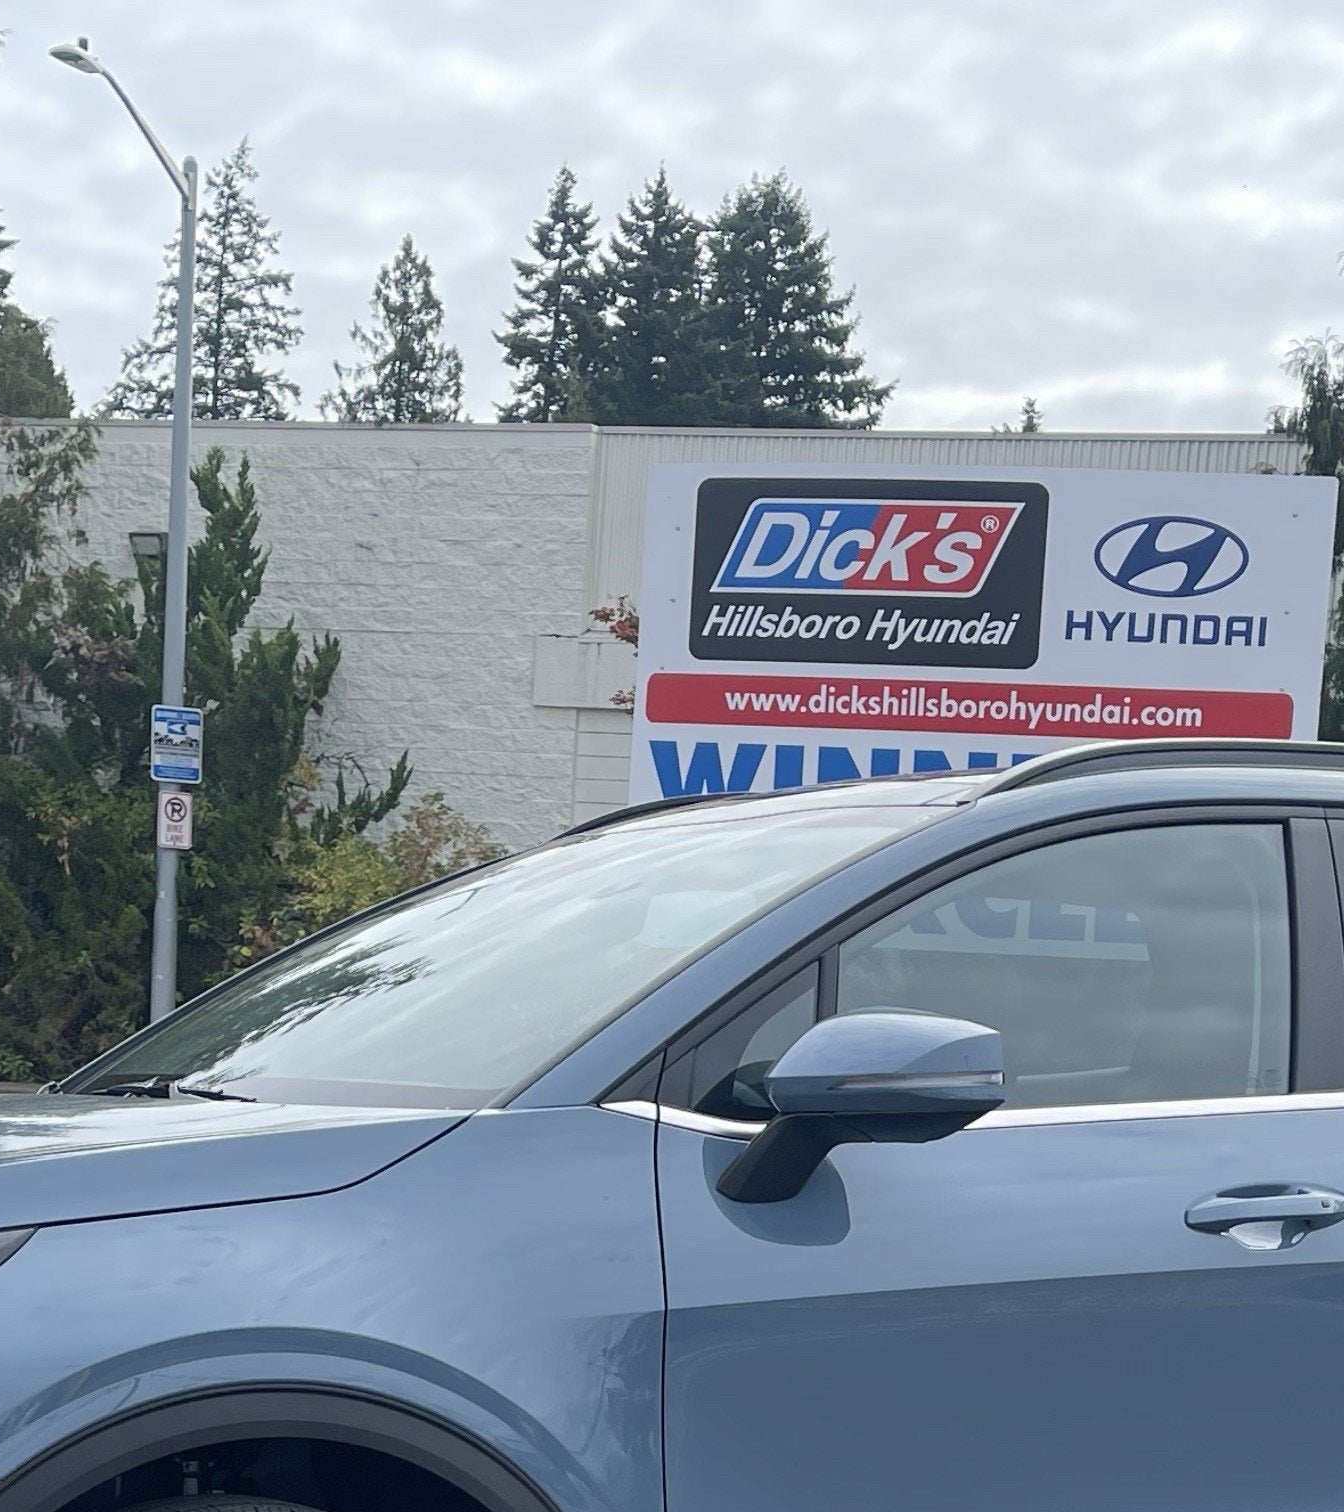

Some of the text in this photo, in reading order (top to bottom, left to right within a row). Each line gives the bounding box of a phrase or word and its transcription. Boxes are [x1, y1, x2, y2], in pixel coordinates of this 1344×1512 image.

[701, 605, 1021, 650] Hillsboro Hyundai
[1065, 609, 1268, 647] HYUNDAI
[724, 684, 1203, 730] www.dickshillsborohyundai.com
